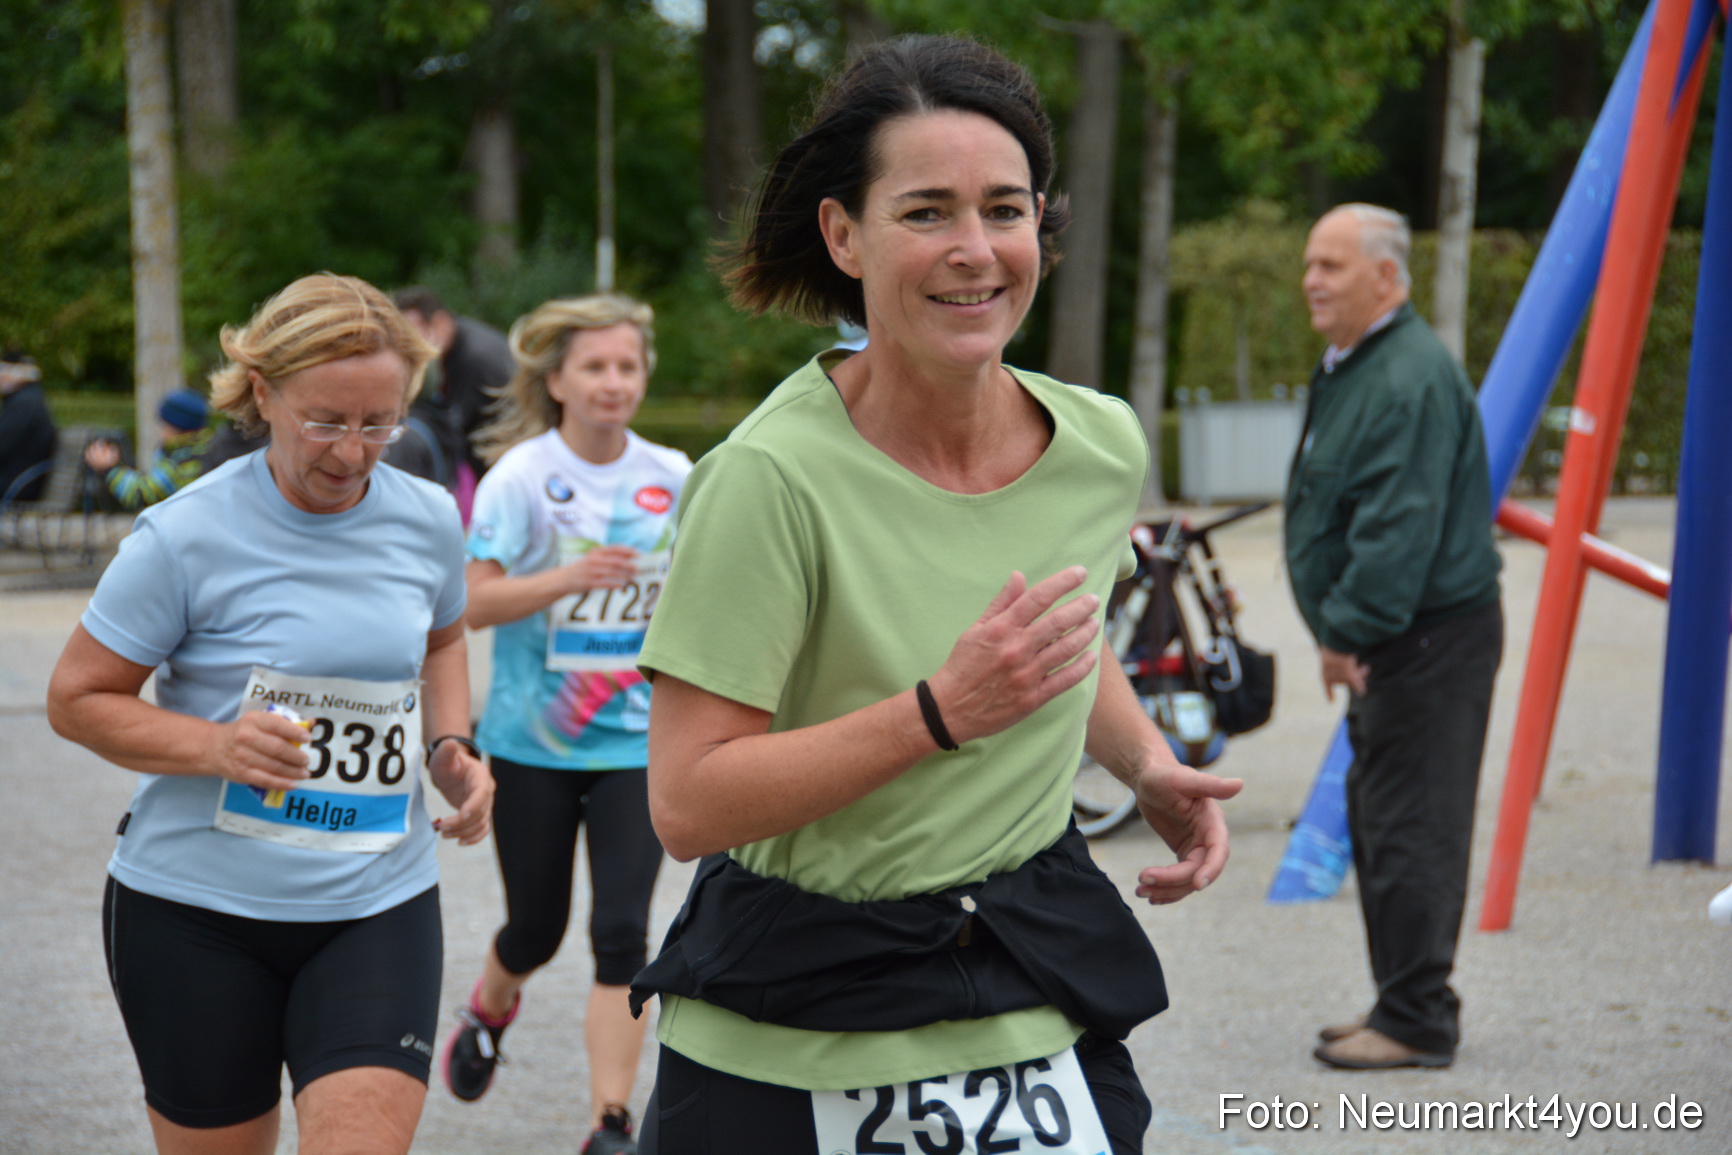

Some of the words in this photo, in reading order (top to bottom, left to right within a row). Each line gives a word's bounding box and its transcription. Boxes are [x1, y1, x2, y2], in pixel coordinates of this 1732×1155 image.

[250, 684, 315, 707] PARTL
[307, 717, 407, 786] 338
[285, 796, 358, 832] Helga
[844, 1057, 1072, 1155] 2526
